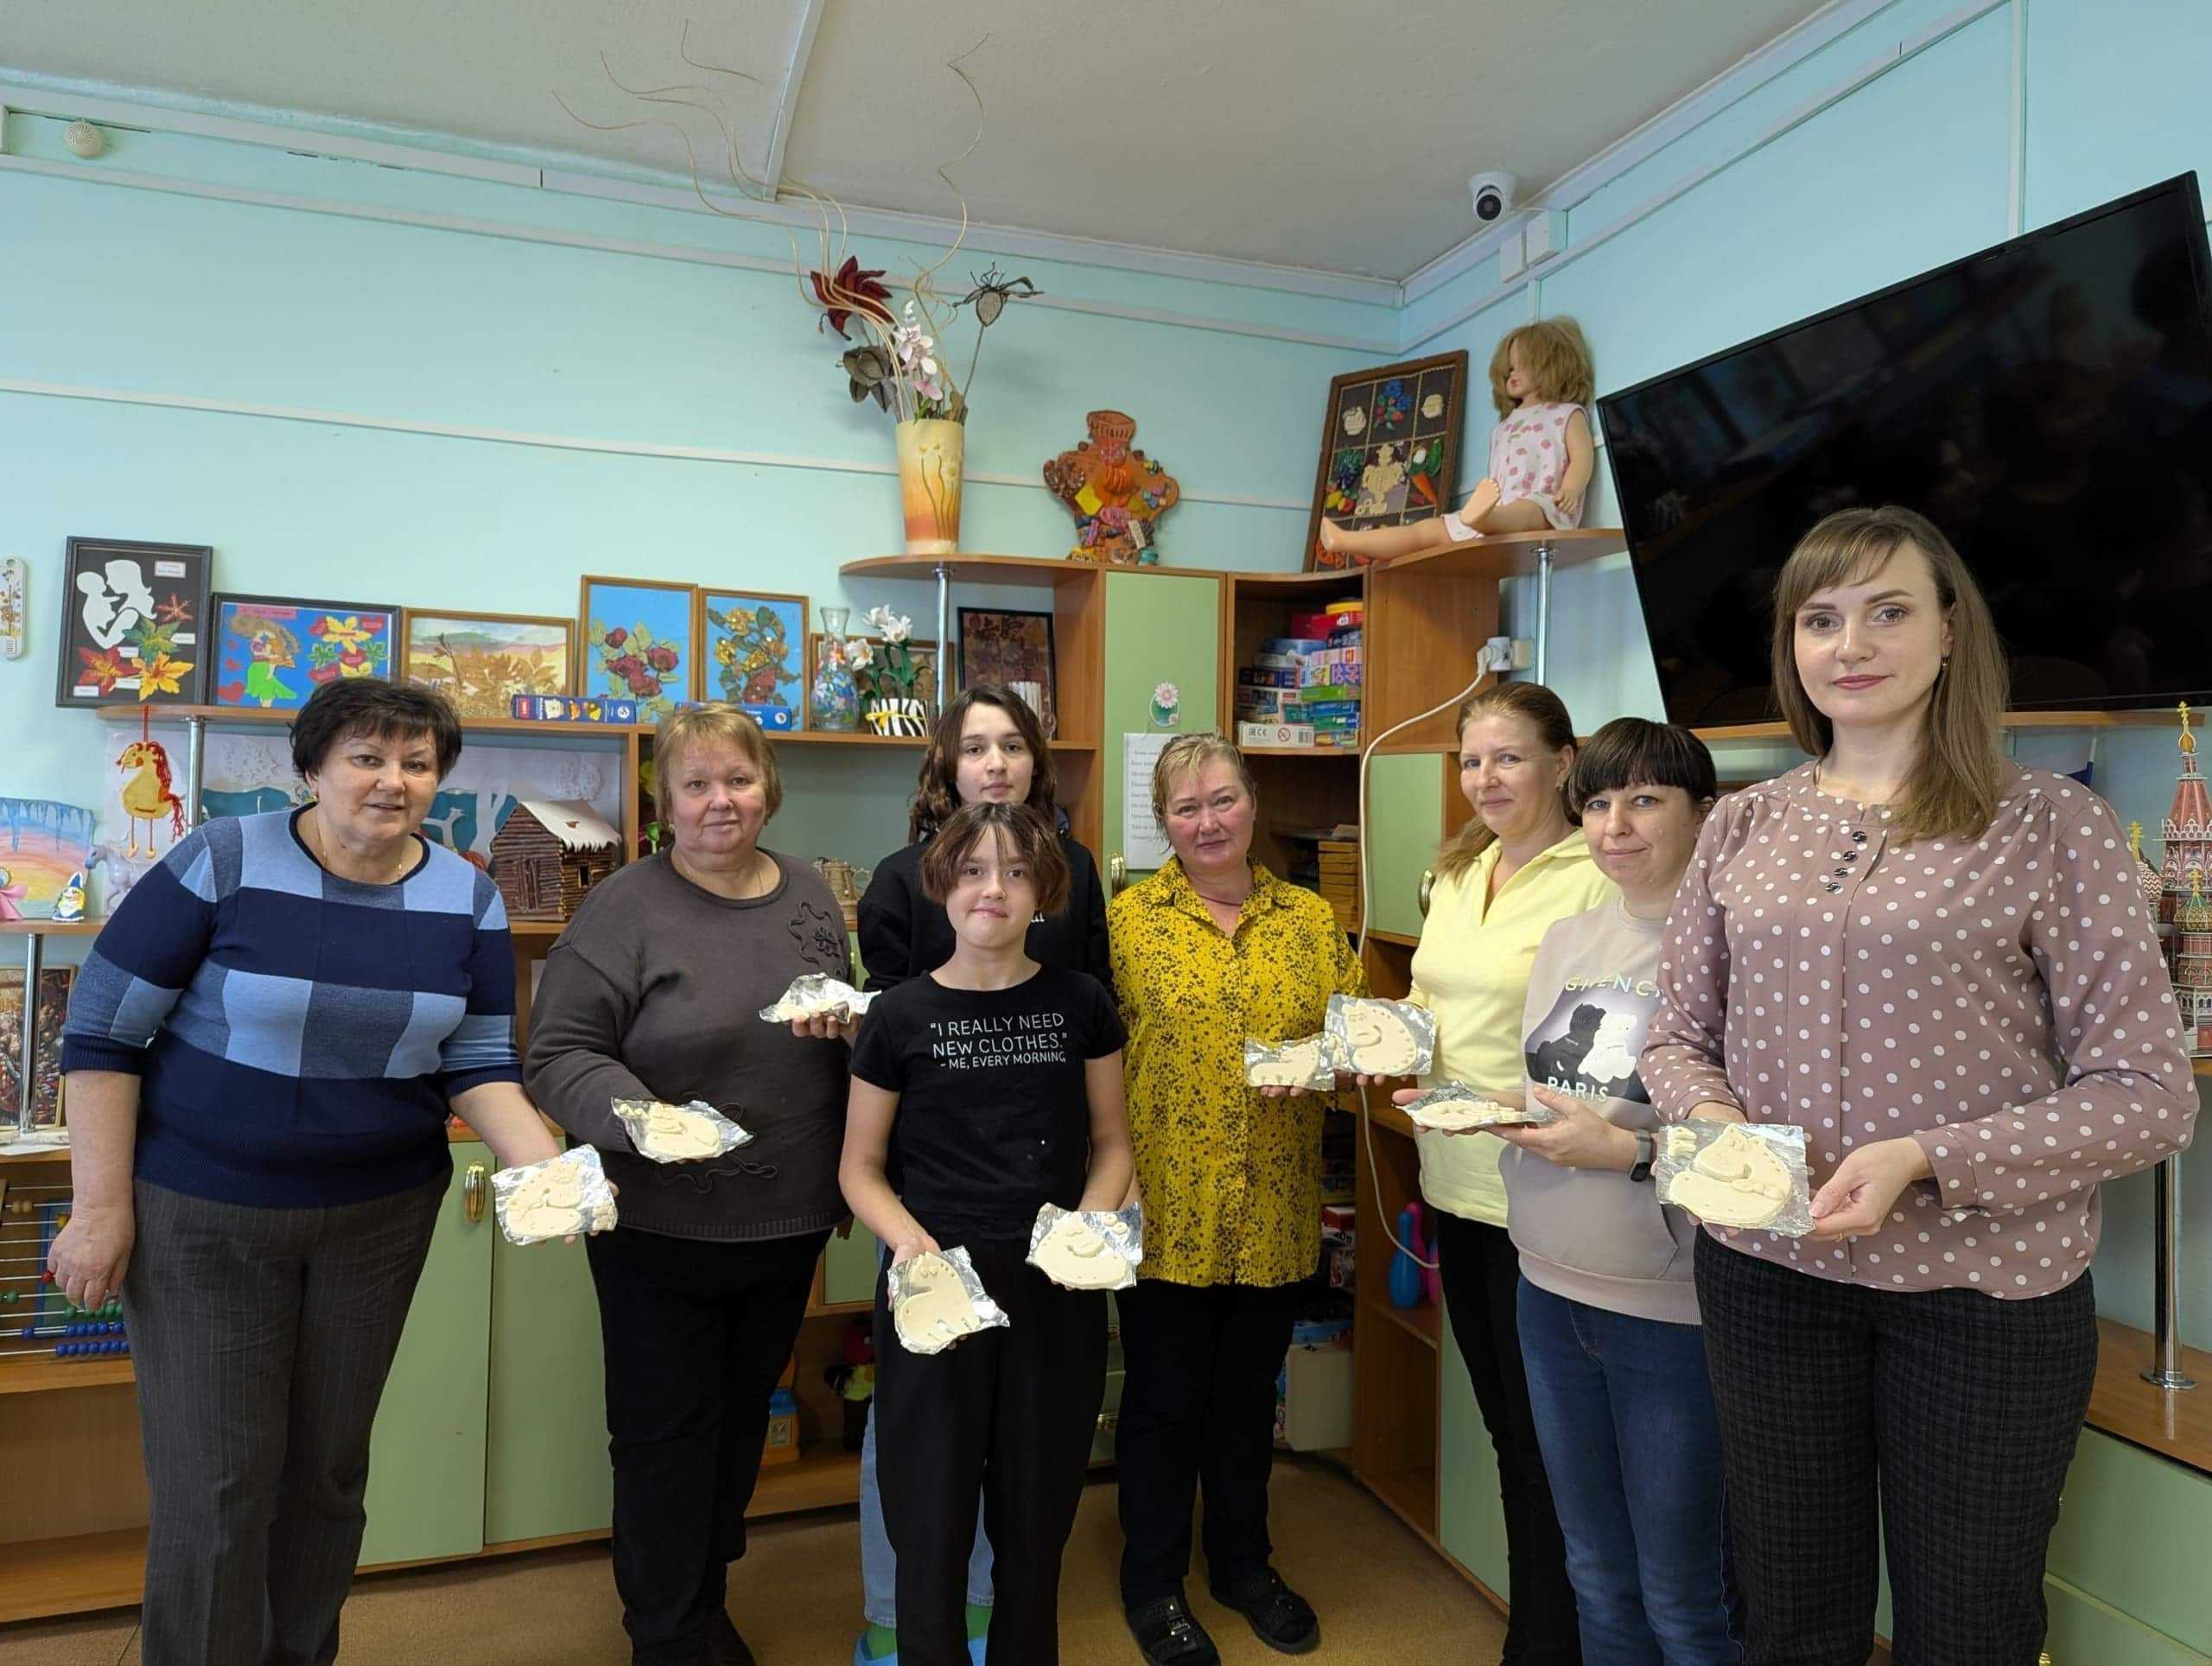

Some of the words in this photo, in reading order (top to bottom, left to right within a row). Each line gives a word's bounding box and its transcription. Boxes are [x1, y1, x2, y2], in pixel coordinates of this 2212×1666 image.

[948, 1016, 1014, 1036] REALLY
[1019, 1013, 1065, 1031] NEED
[933, 1040, 973, 1059] NEW
[949, 1057, 970, 1071] ME,
[972, 1054, 1010, 1068] EVERY
[1013, 1051, 1067, 1065] MORNING
[1548, 1076, 1610, 1103] PARIS
